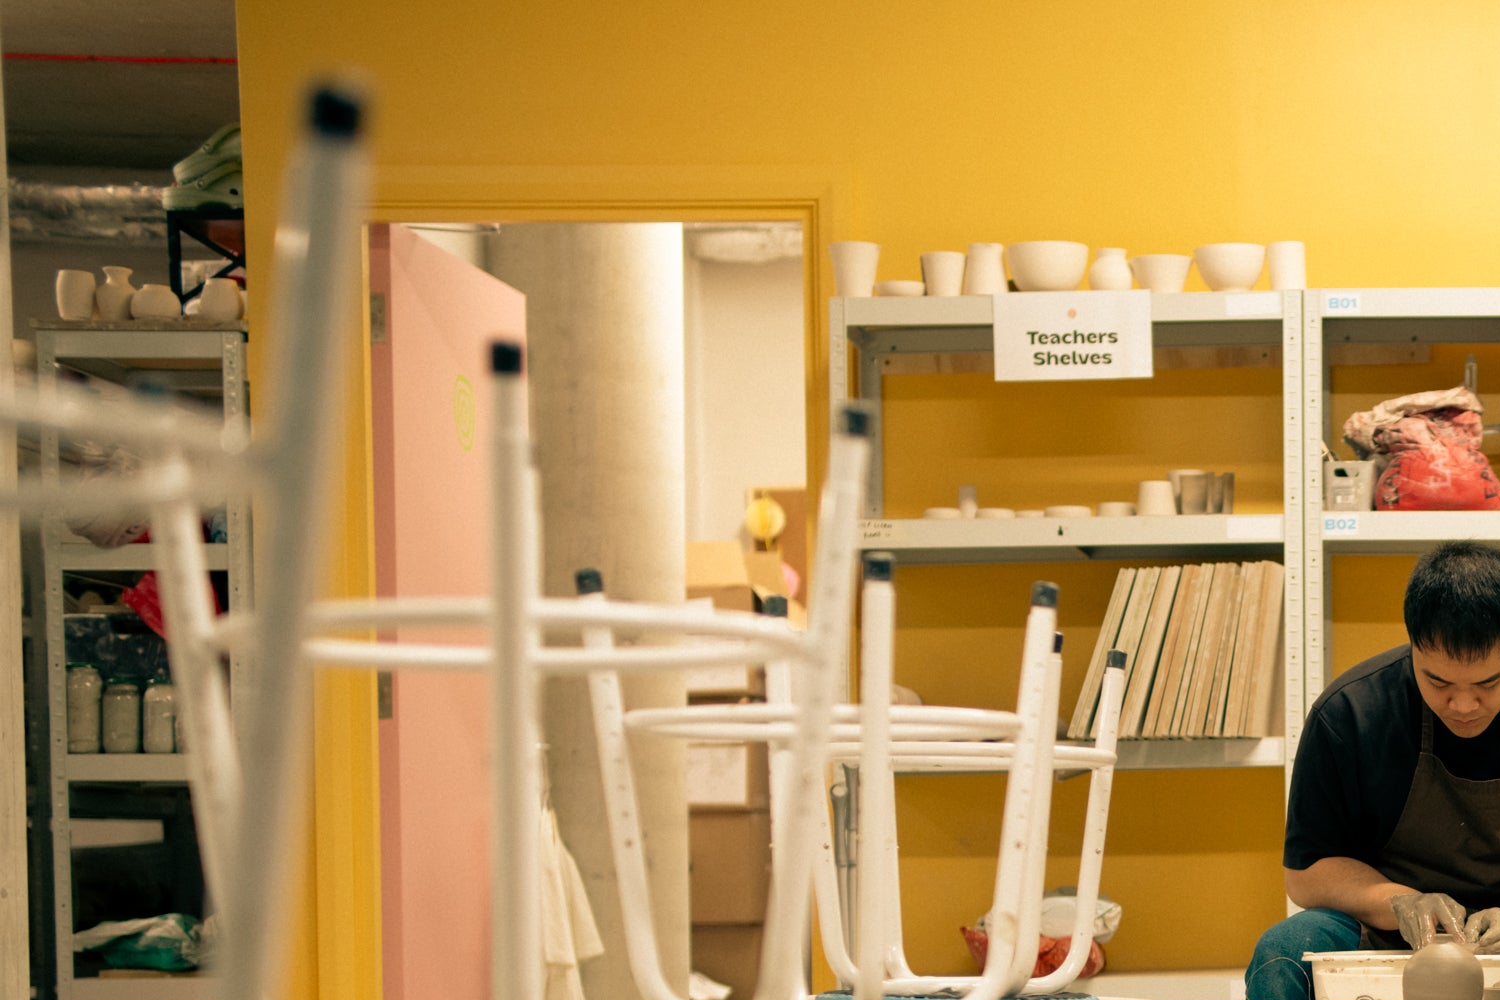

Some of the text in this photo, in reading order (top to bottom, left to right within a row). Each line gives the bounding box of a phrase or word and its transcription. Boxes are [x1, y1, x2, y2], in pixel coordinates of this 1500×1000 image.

[1328, 298, 1357, 308] B01
[1026, 330, 1118, 345] Teachers
[1033, 351, 1112, 366] Shelves
[1325, 519, 1356, 530] B02
